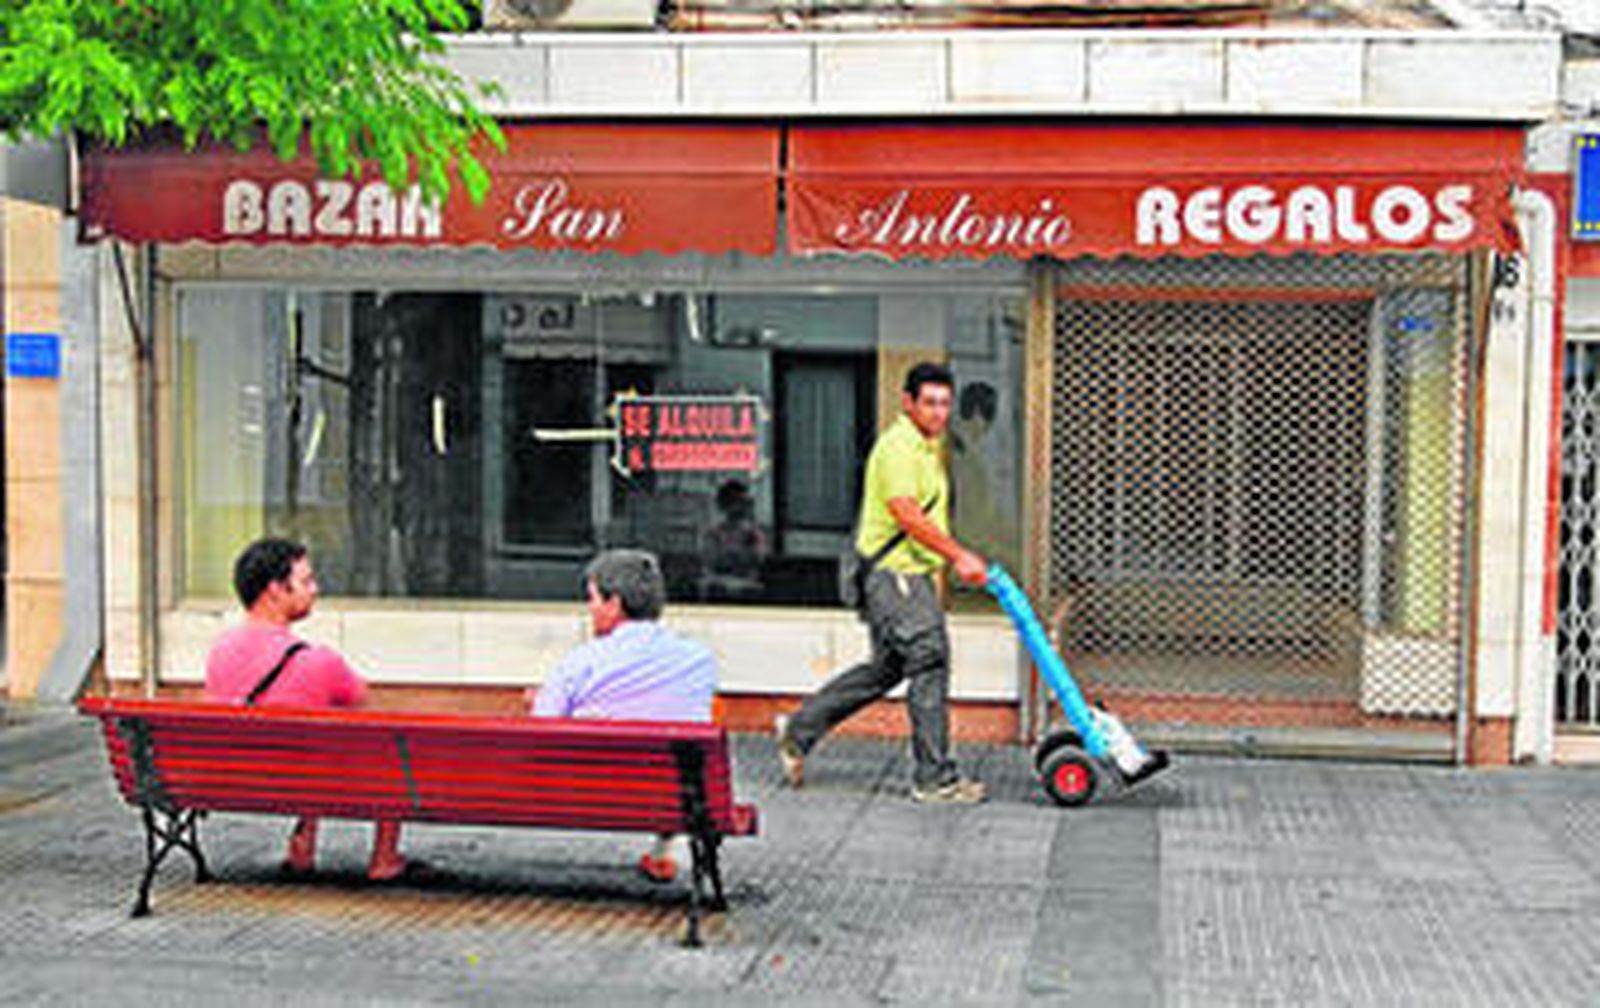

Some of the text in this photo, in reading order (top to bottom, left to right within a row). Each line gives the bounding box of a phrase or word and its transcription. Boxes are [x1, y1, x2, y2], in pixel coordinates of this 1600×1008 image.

[504, 178, 624, 241] San
[836, 190, 1073, 249] Antonio
[1135, 184, 1477, 246] REGALOS
[623, 403, 756, 437] SE ALQUILA
